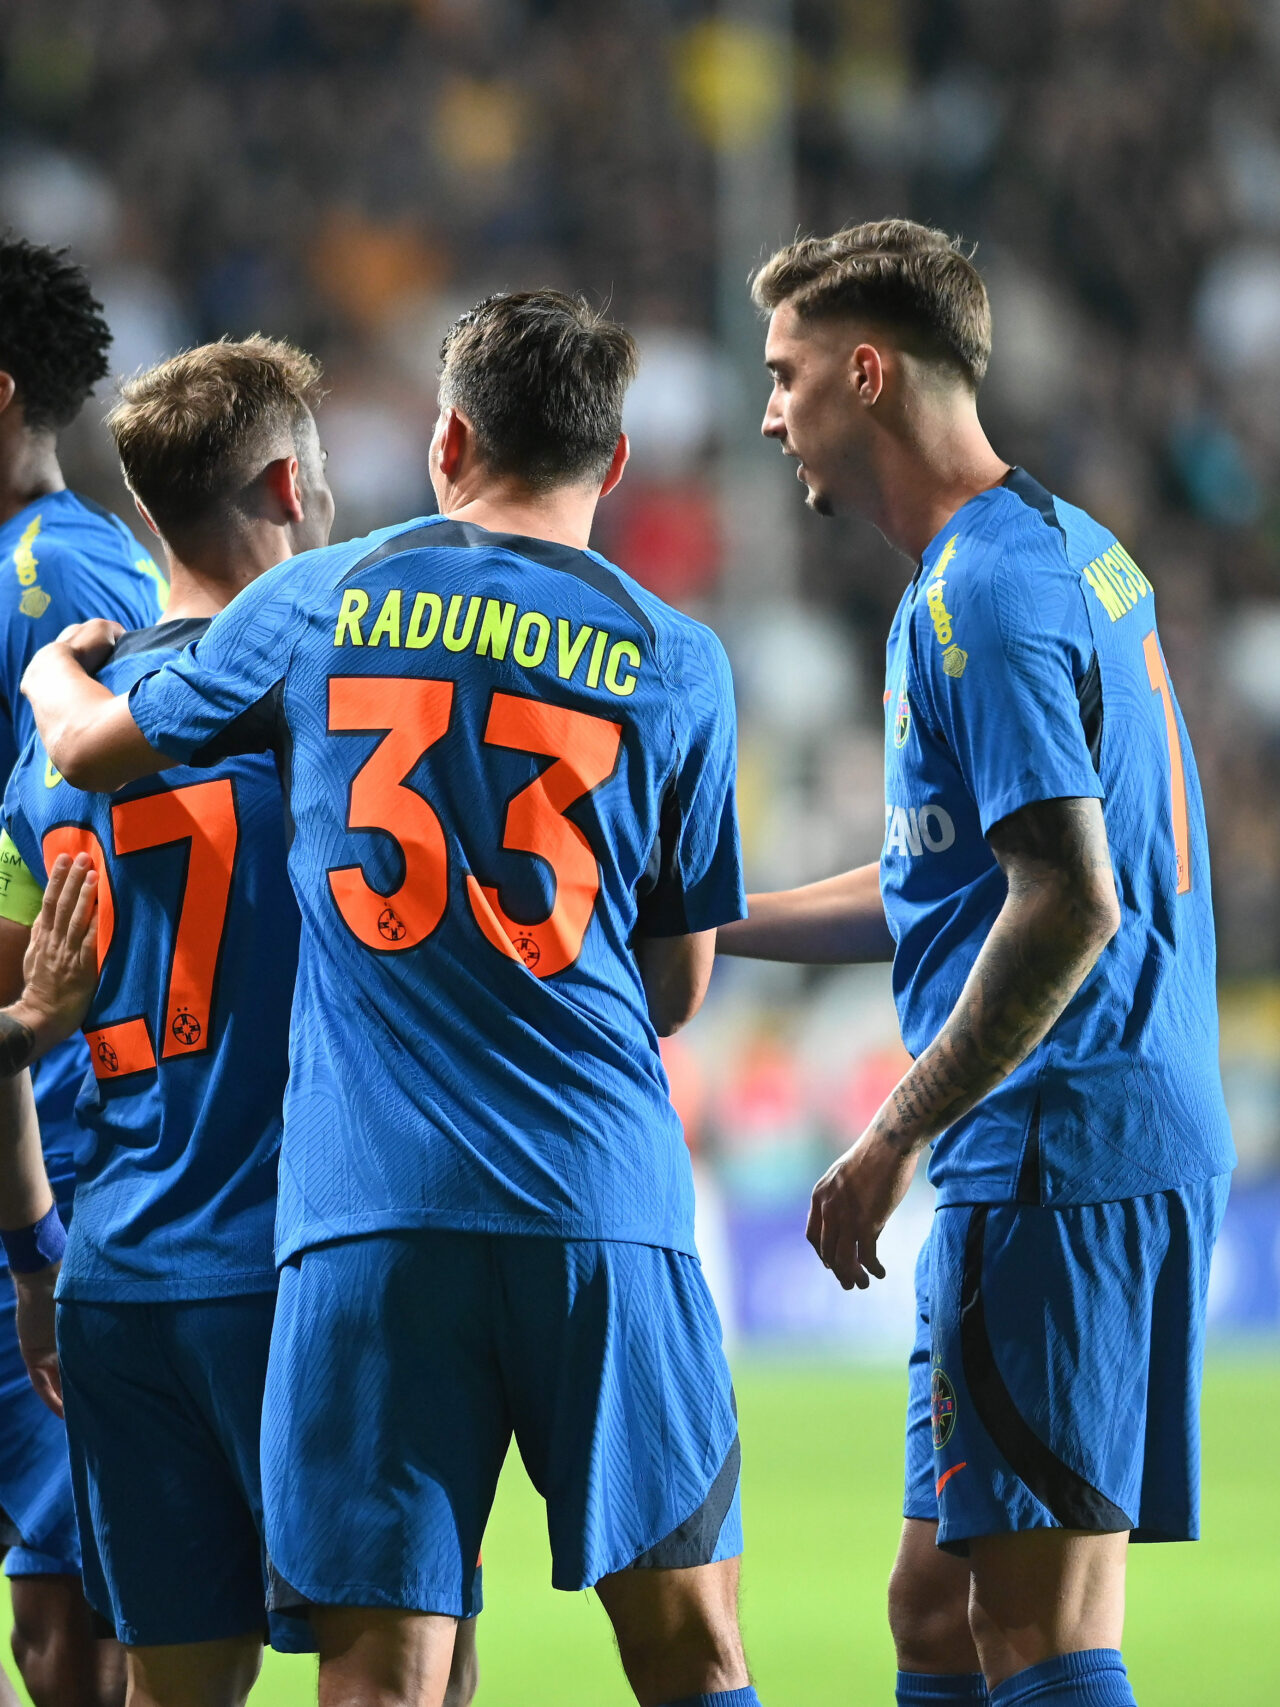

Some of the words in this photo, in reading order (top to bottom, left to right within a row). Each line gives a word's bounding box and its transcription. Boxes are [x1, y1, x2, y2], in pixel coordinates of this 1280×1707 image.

[333, 588, 641, 696] RADUNOVIC
[1142, 629, 1192, 895] 1
[326, 675, 623, 981] 33
